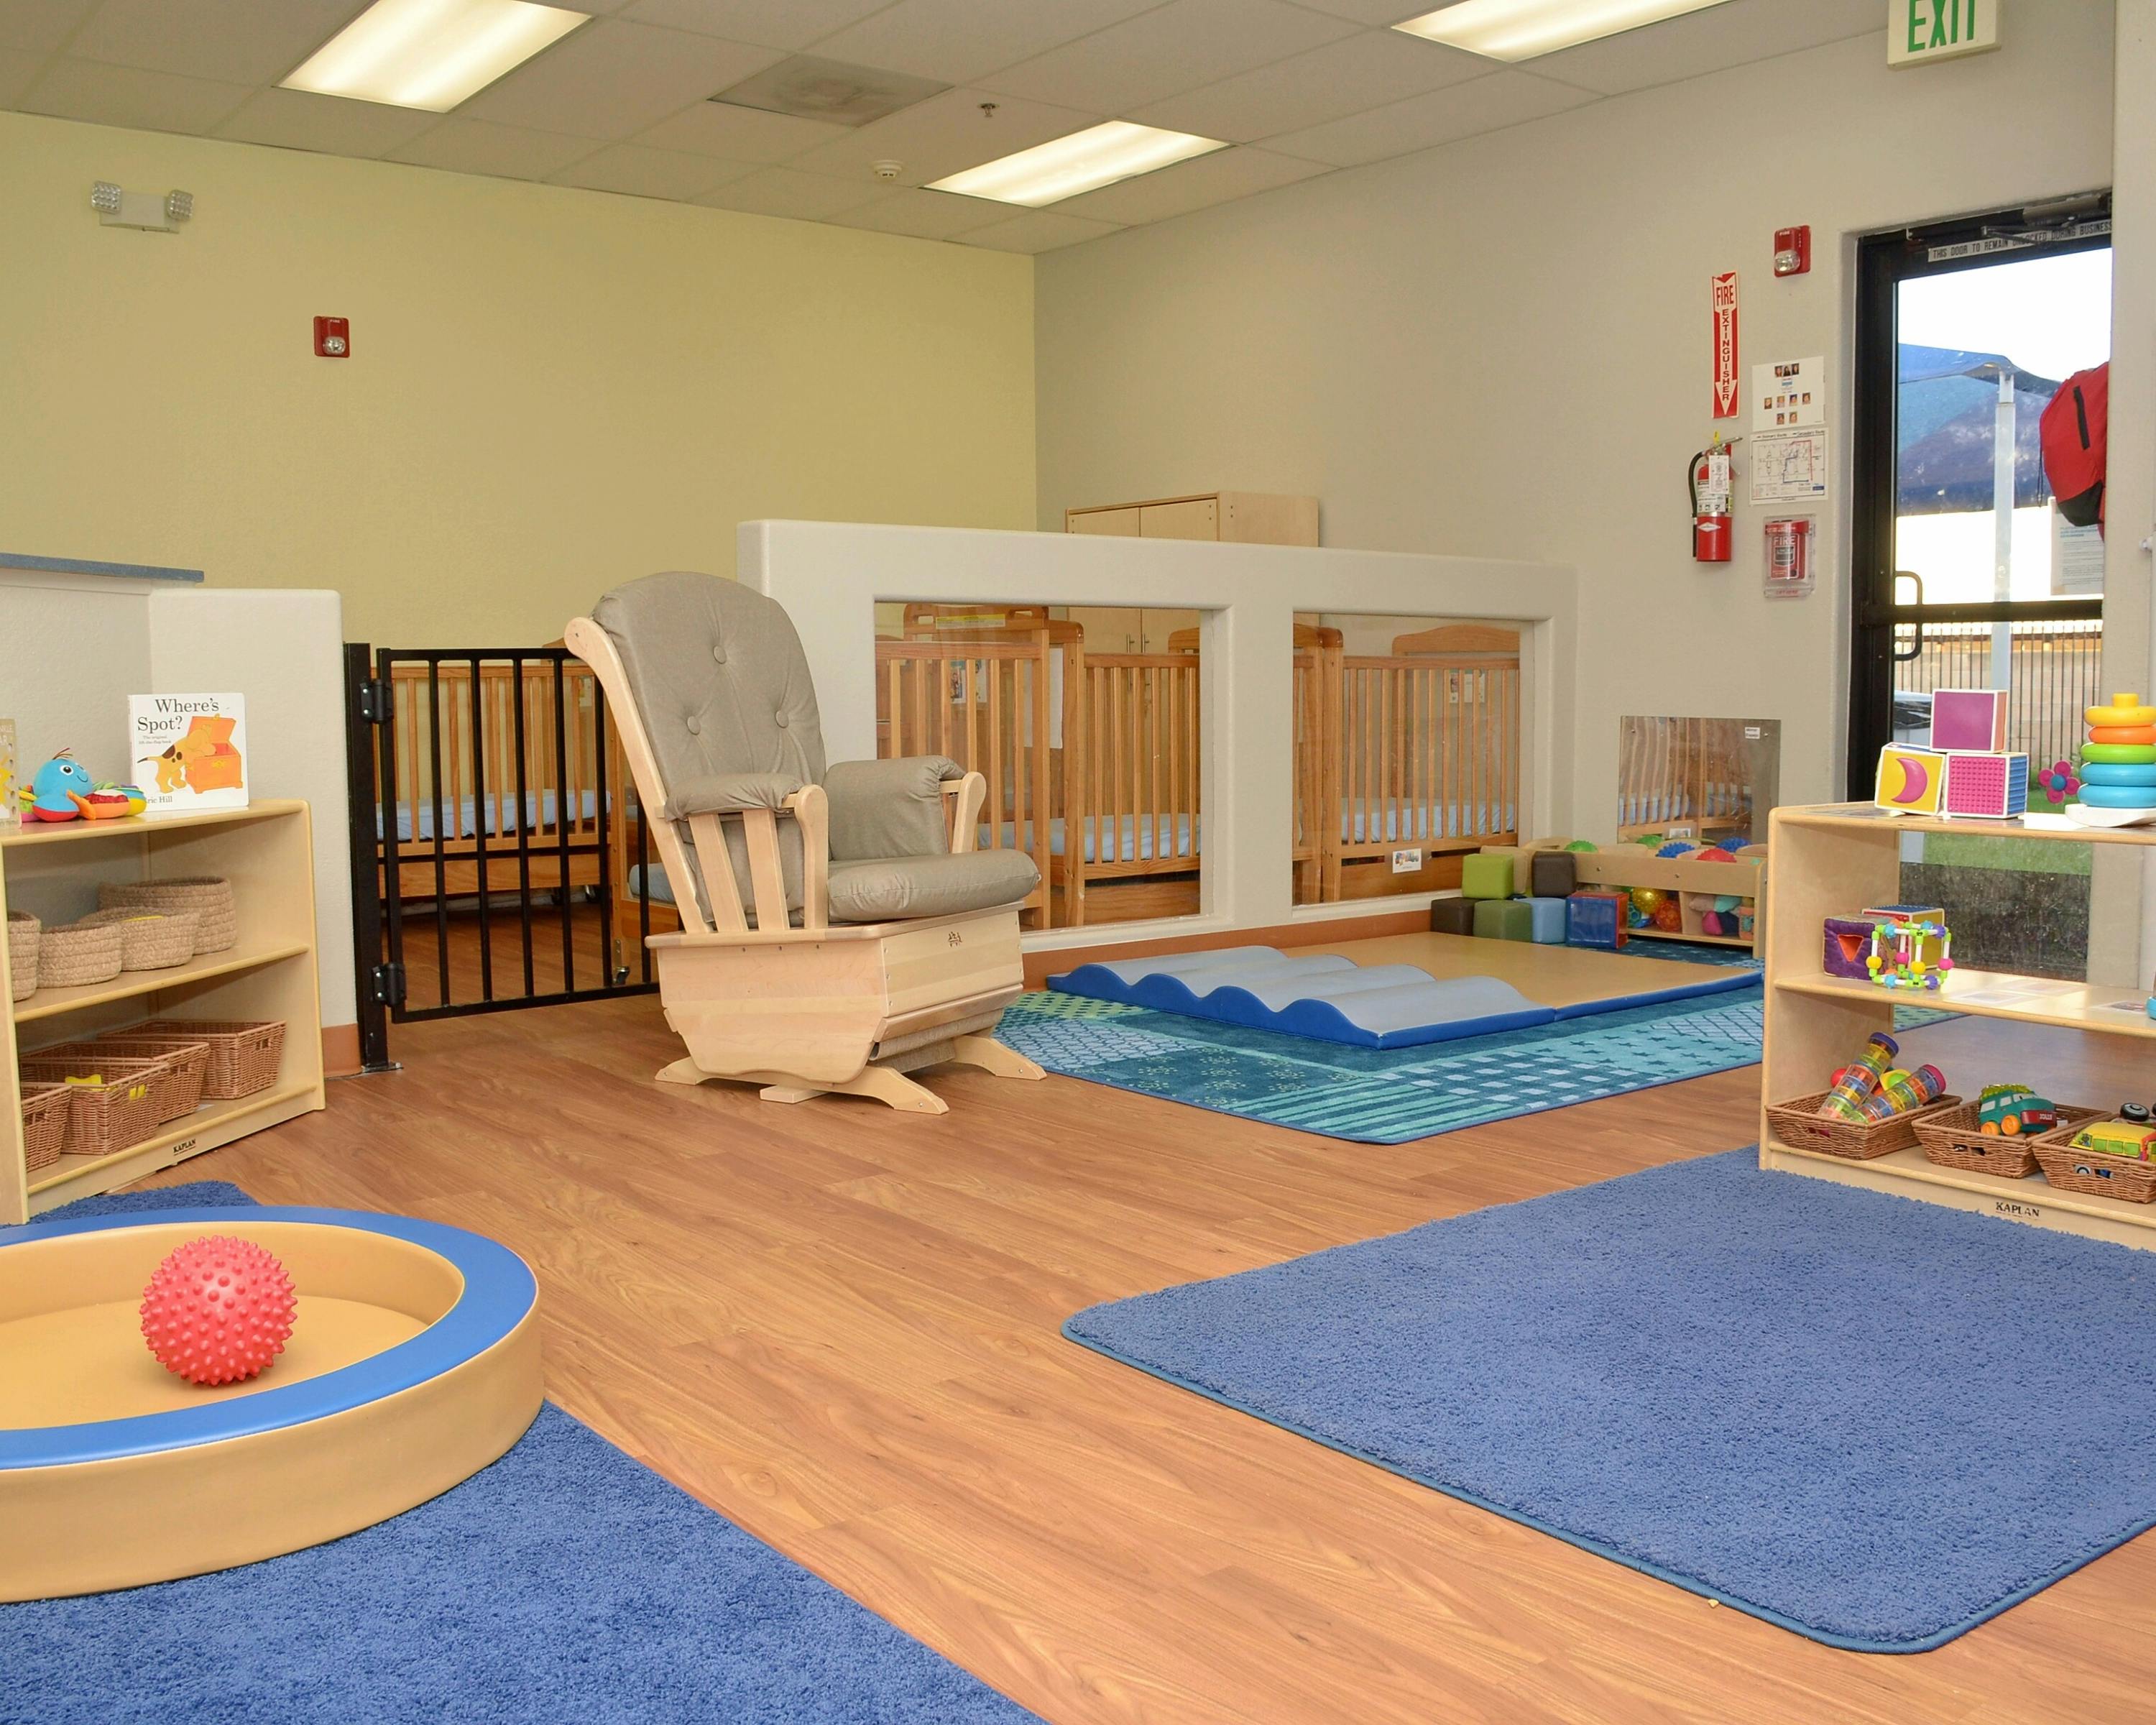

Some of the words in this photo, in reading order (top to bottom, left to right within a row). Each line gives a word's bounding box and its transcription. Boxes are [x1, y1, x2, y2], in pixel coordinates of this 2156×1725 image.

[1932, 249, 1947, 259] THIS
[1950, 246, 1968, 257] DOOR
[1972, 244, 1981, 252] TO
[1984, 239, 2008, 251] REMAIN
[1716, 285, 1733, 306] FIRE
[1774, 535, 1795, 546] FIRE
[155, 698, 219, 713] Where's
[137, 715, 183, 734] Spot?
[173, 1138, 195, 1153] KAPLAN
[1996, 1202, 2040, 1217] KAPLAN
